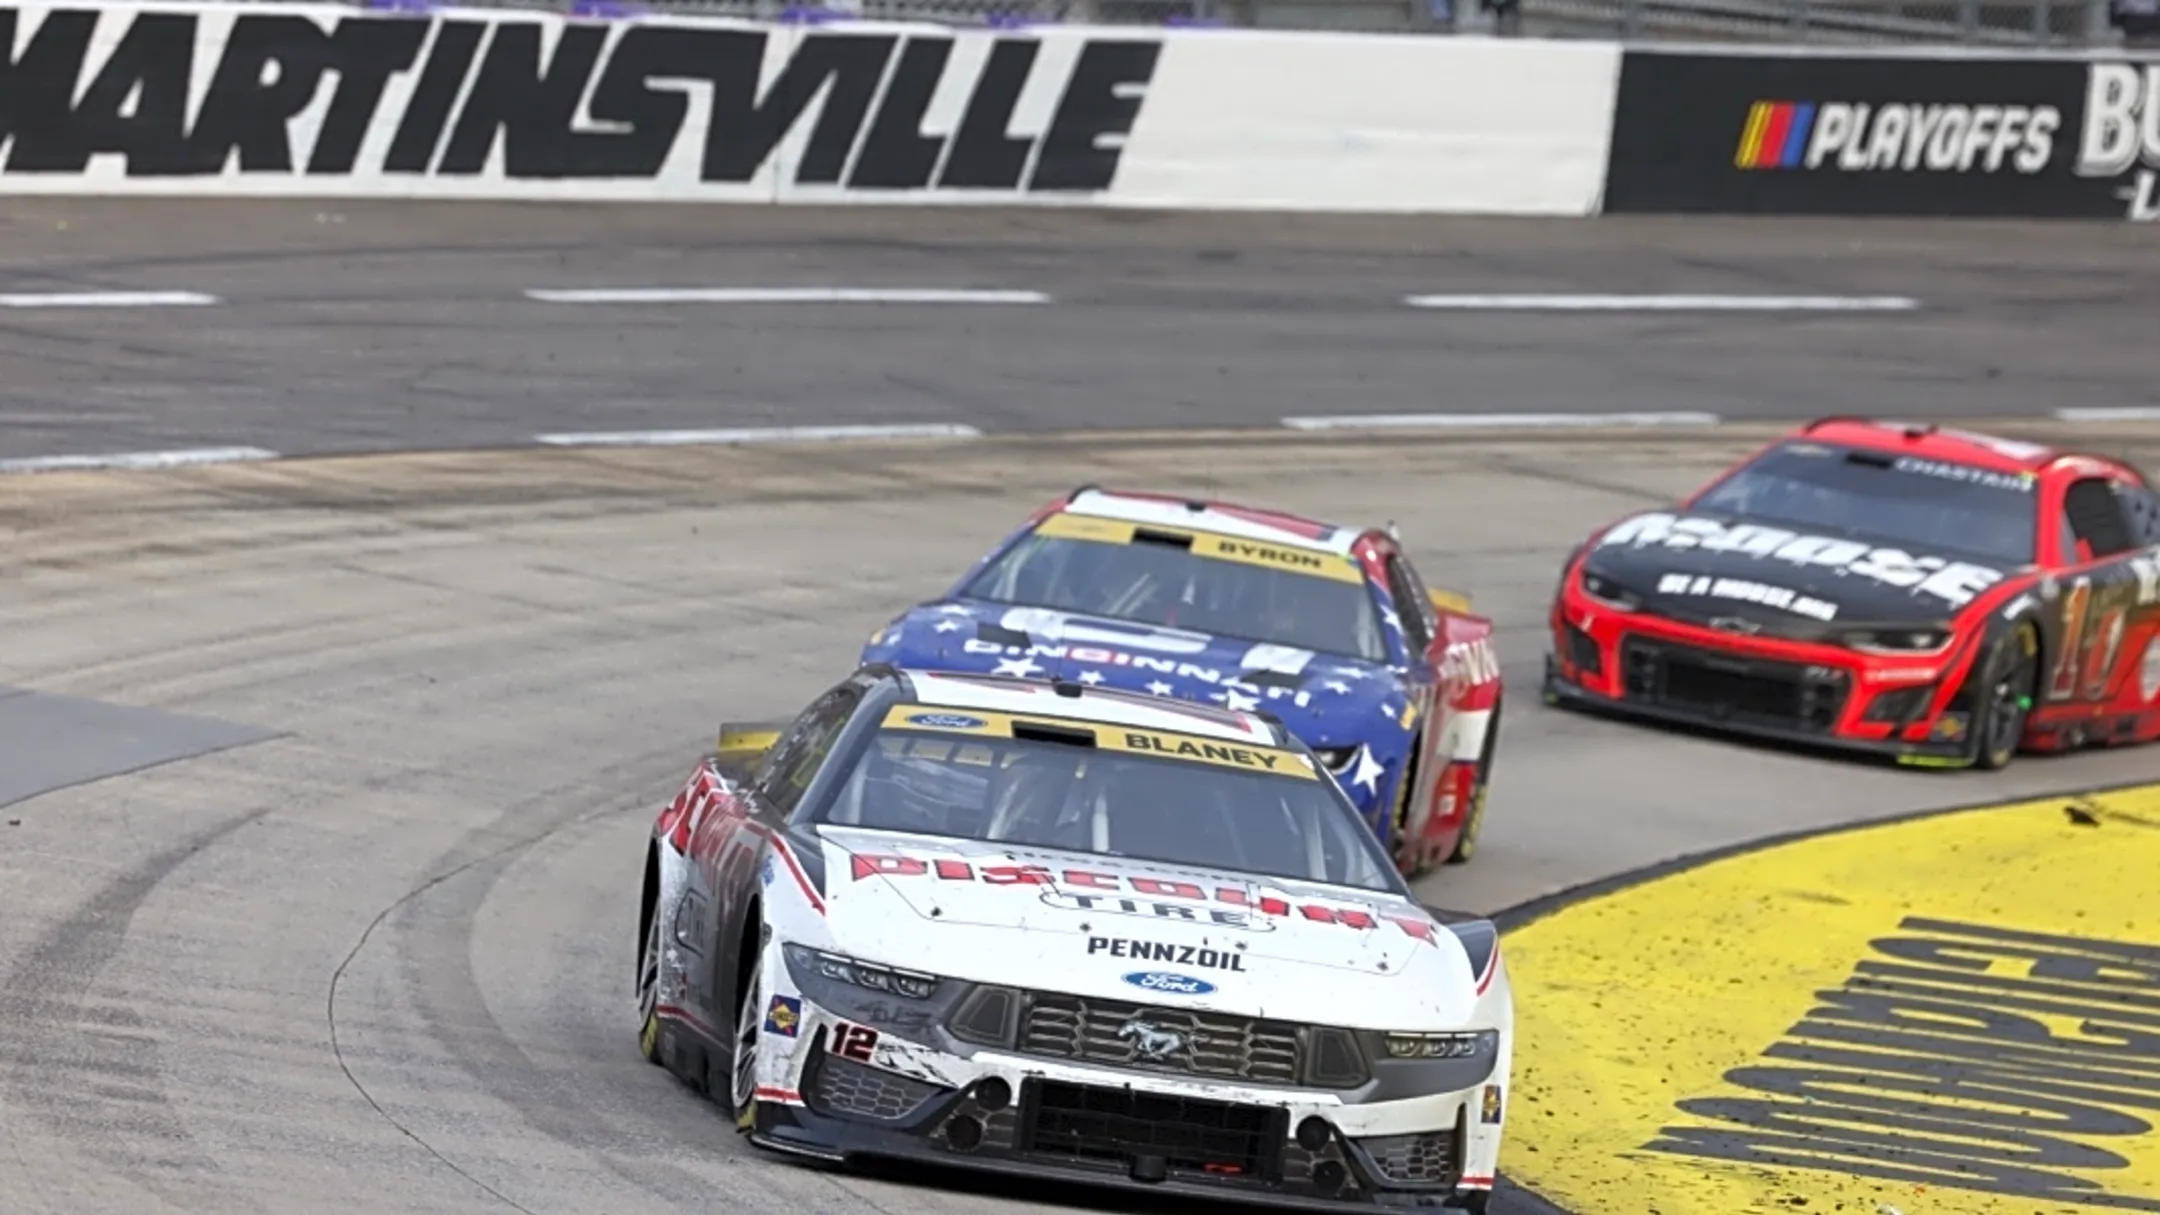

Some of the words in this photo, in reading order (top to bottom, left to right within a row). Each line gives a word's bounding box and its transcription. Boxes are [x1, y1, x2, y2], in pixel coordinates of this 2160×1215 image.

[0, 8, 1162, 191] MARTINSVILLE
[1805, 101, 2060, 173] PLAYOFFS
[1894, 456, 2033, 493] CHASTAIN
[1217, 541, 1322, 568] BYRON
[1600, 512, 2004, 608] MOOSE
[1690, 576, 1711, 595] A
[1125, 732, 1279, 770] BLANEY
[850, 853, 1439, 948] DISCOUNT
[1076, 895, 1250, 927] TIRE
[1088, 936, 1247, 973] PENNZOIL
[1140, 973, 1201, 994] Ford
[831, 1021, 879, 1062] 12
